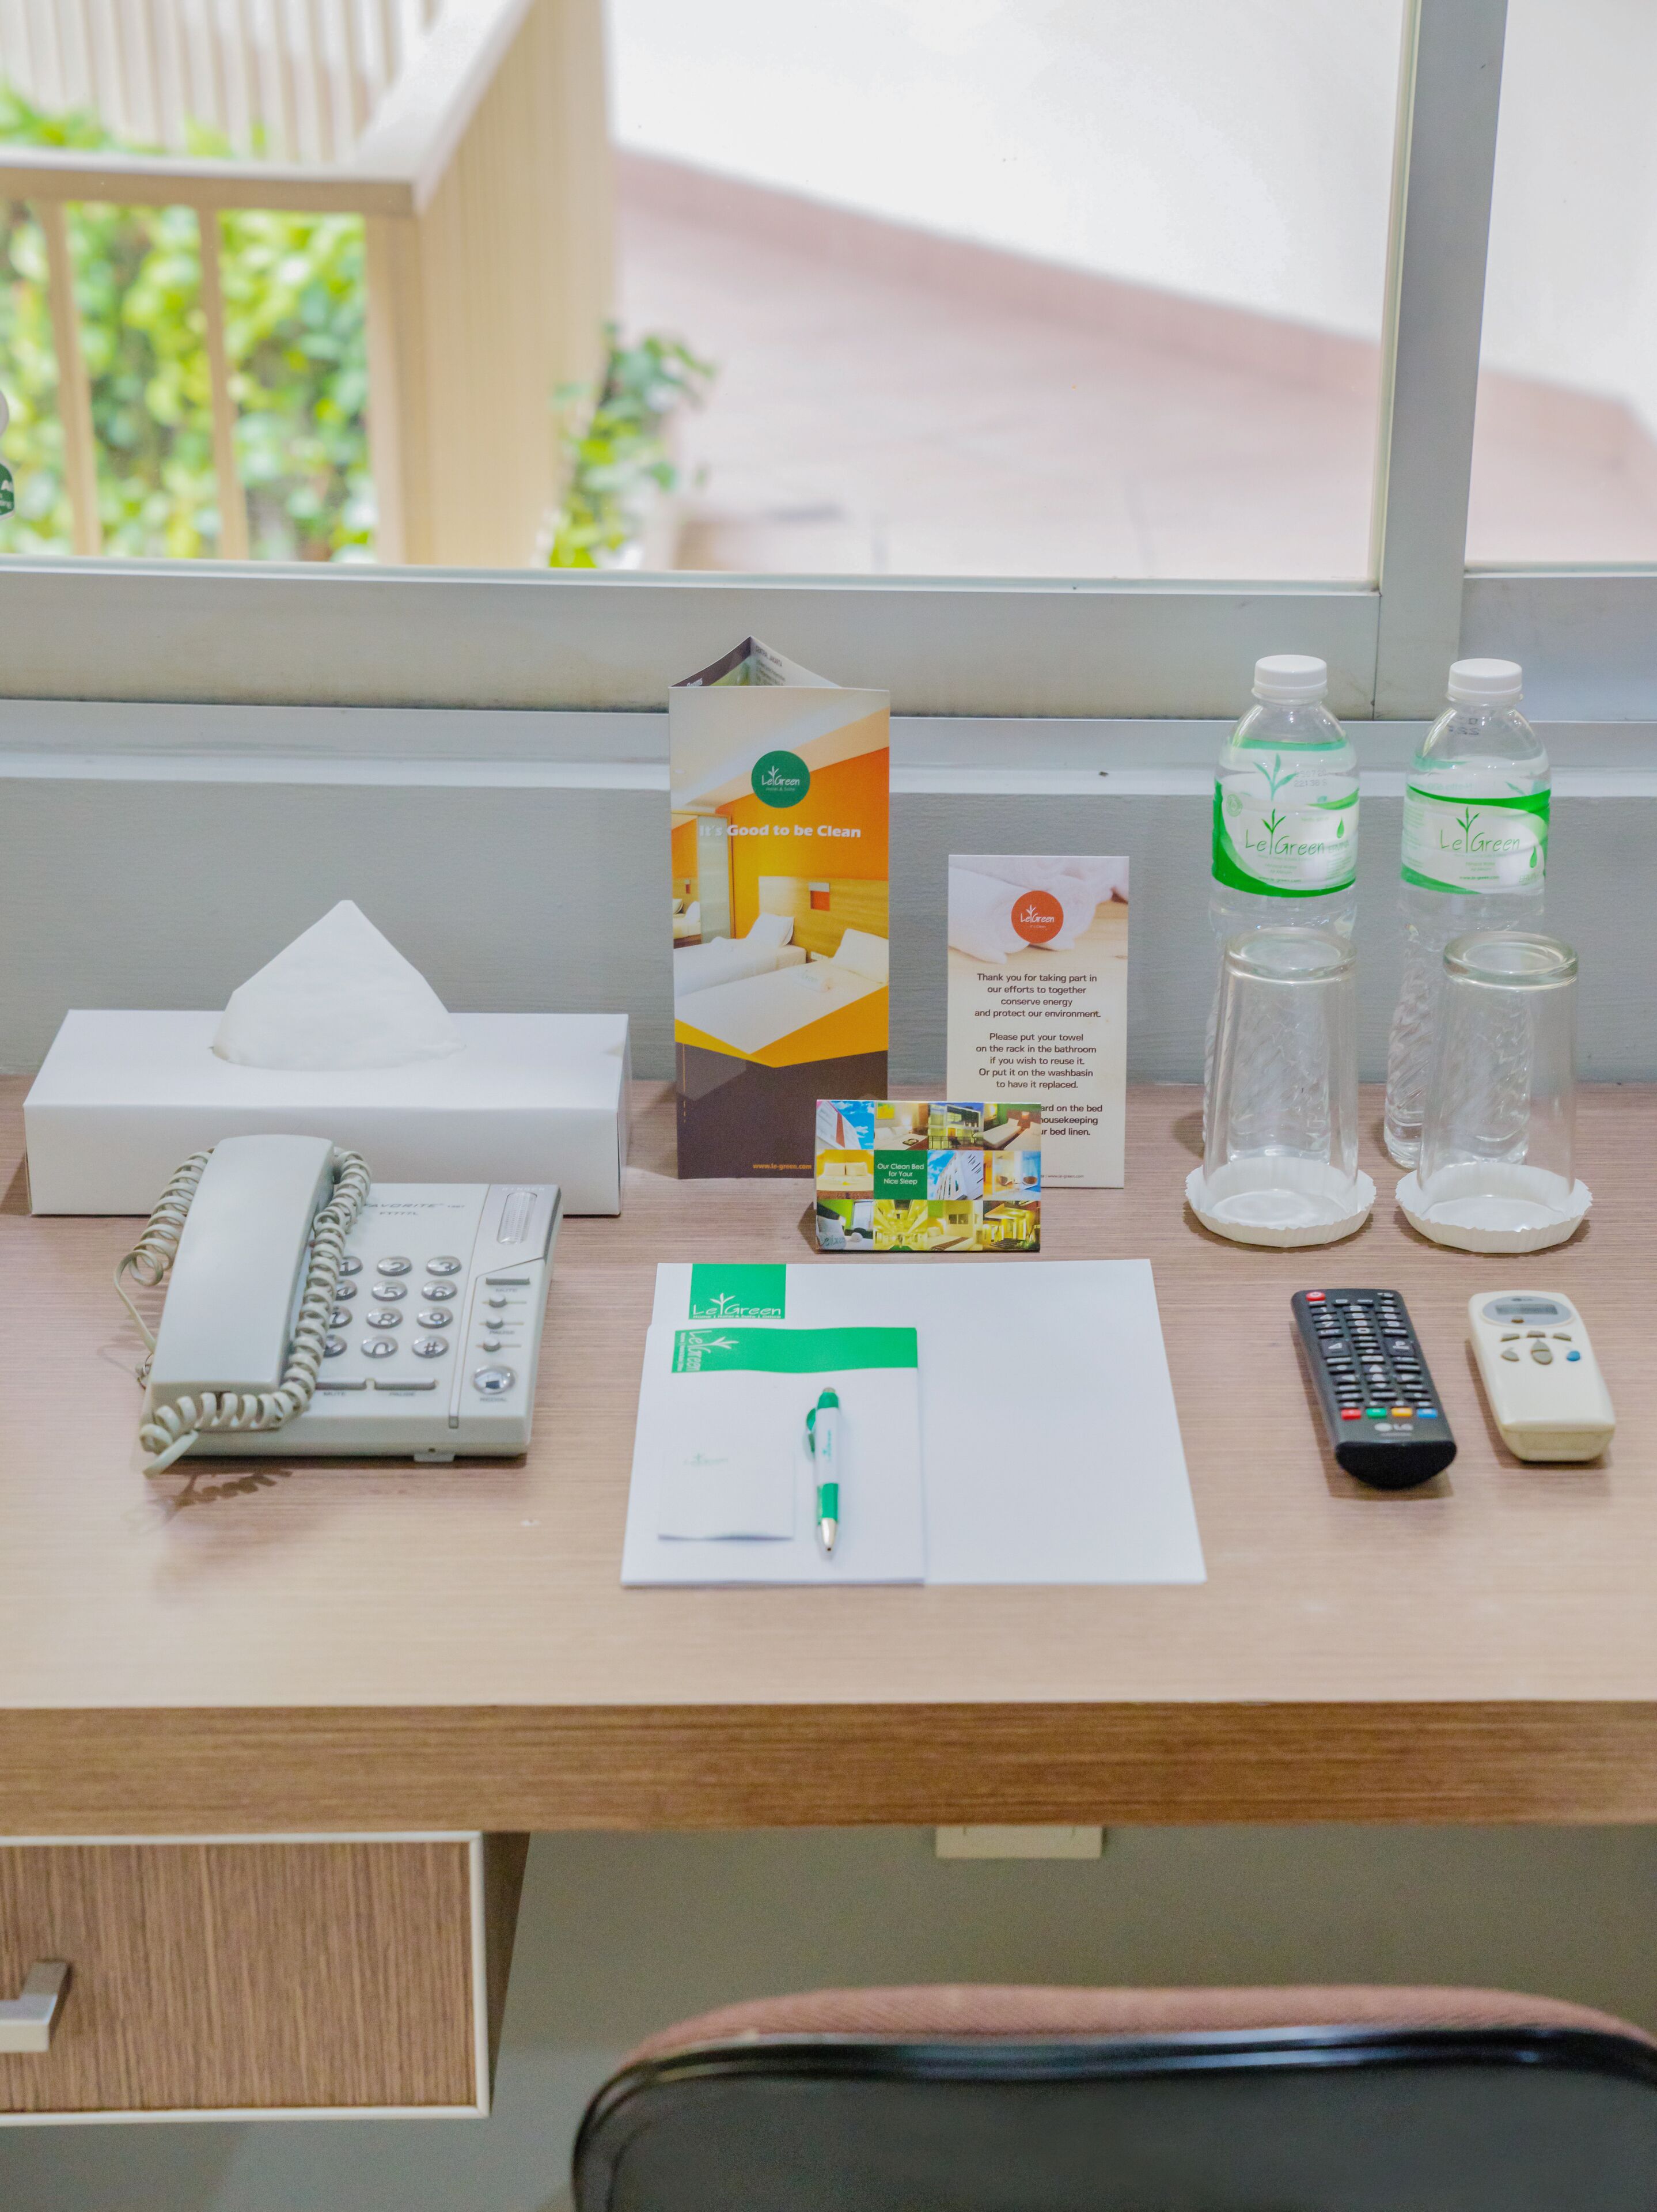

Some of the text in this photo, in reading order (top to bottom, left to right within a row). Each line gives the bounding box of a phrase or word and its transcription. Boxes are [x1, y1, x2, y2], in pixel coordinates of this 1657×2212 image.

[700, 825, 861, 838] It's Good to be Clean
[1040, 974, 1066, 983] taking
[1069, 975, 1087, 983] part
[1049, 986, 1086, 995] together
[1021, 1034, 1034, 1042] put
[992, 1069, 1007, 1077] put
[1040, 1081, 1078, 1090] replaced.
[342, 1262, 349, 1271] 1
[384, 1286, 398, 1296] 5
[432, 1286, 448, 1297] 6
[378, 1313, 395, 1324] 8
